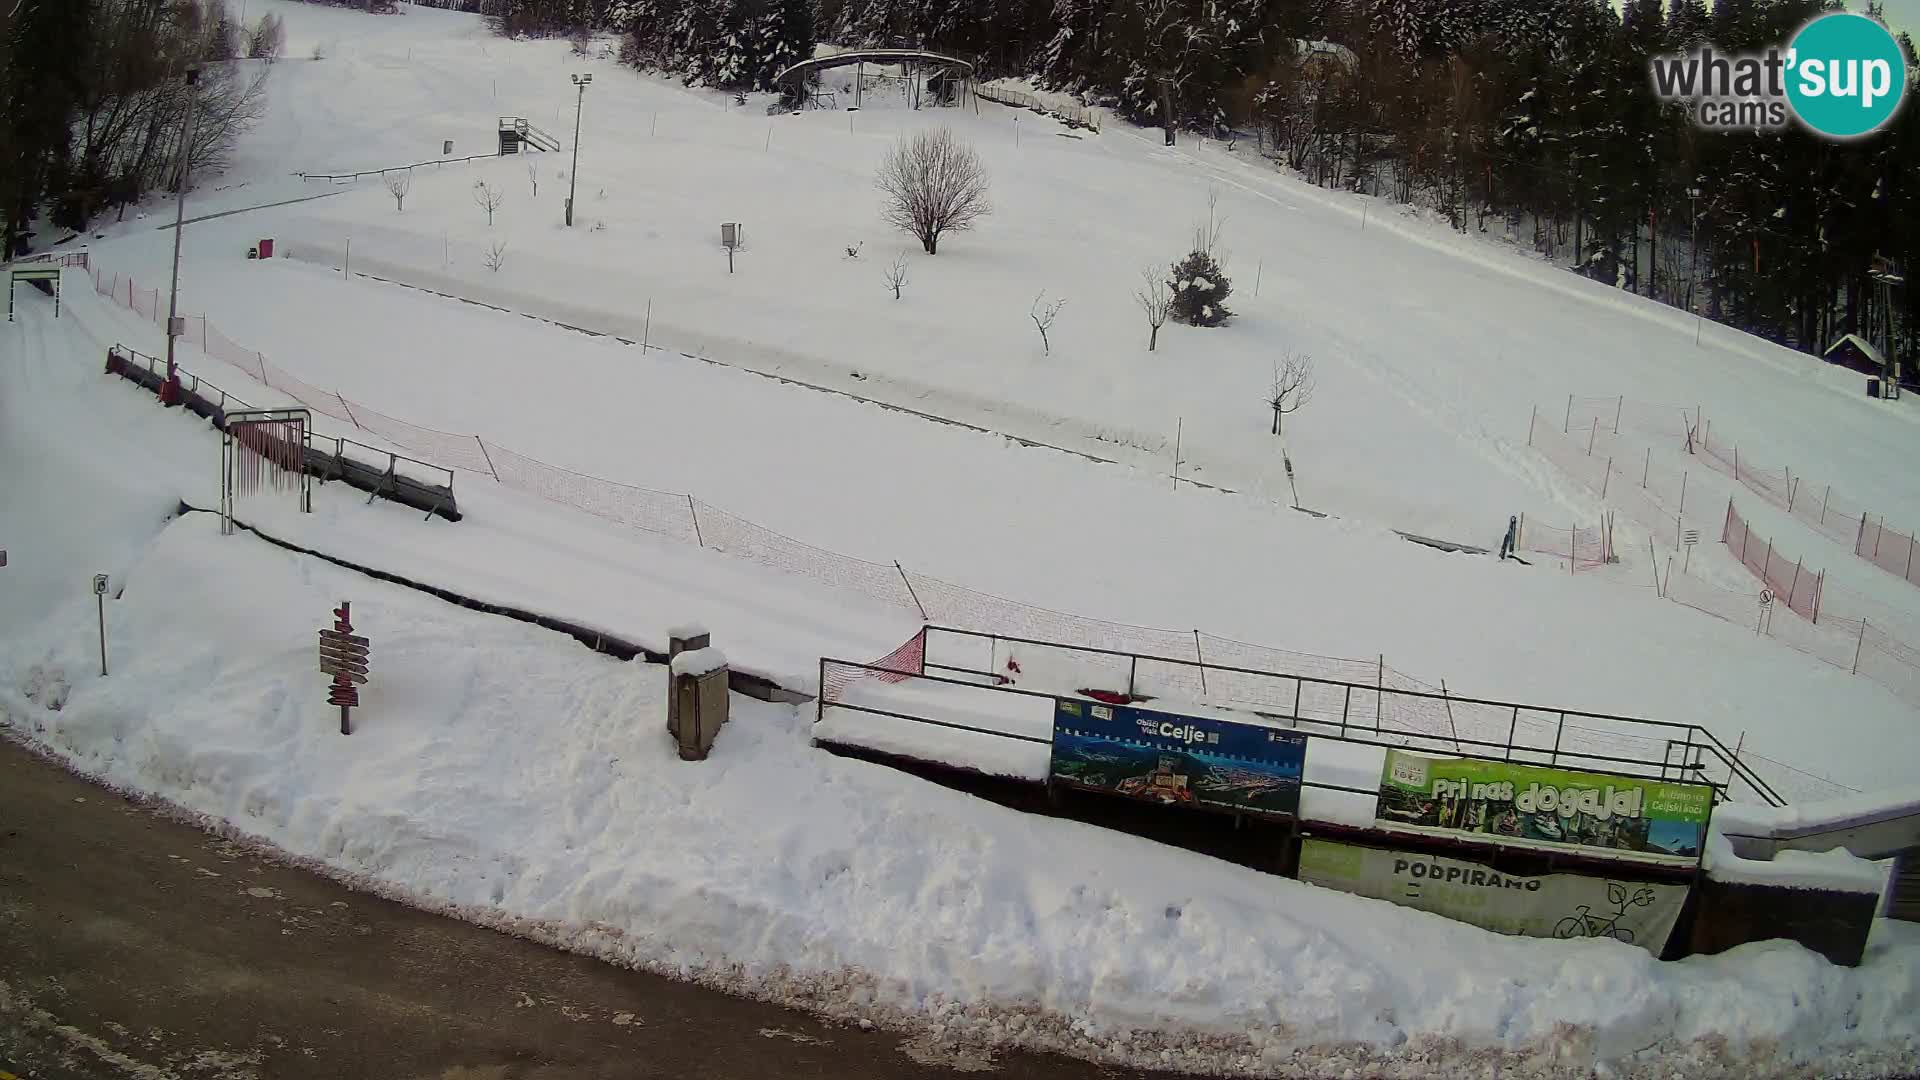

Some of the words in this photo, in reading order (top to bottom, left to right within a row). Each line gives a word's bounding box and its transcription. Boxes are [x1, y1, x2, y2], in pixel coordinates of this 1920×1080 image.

[1160, 722, 1206, 744] Celje
[1431, 776, 1468, 800] Pri
[1471, 780, 1514, 802] nas
[1394, 859, 1541, 892] PODPIRAMO
